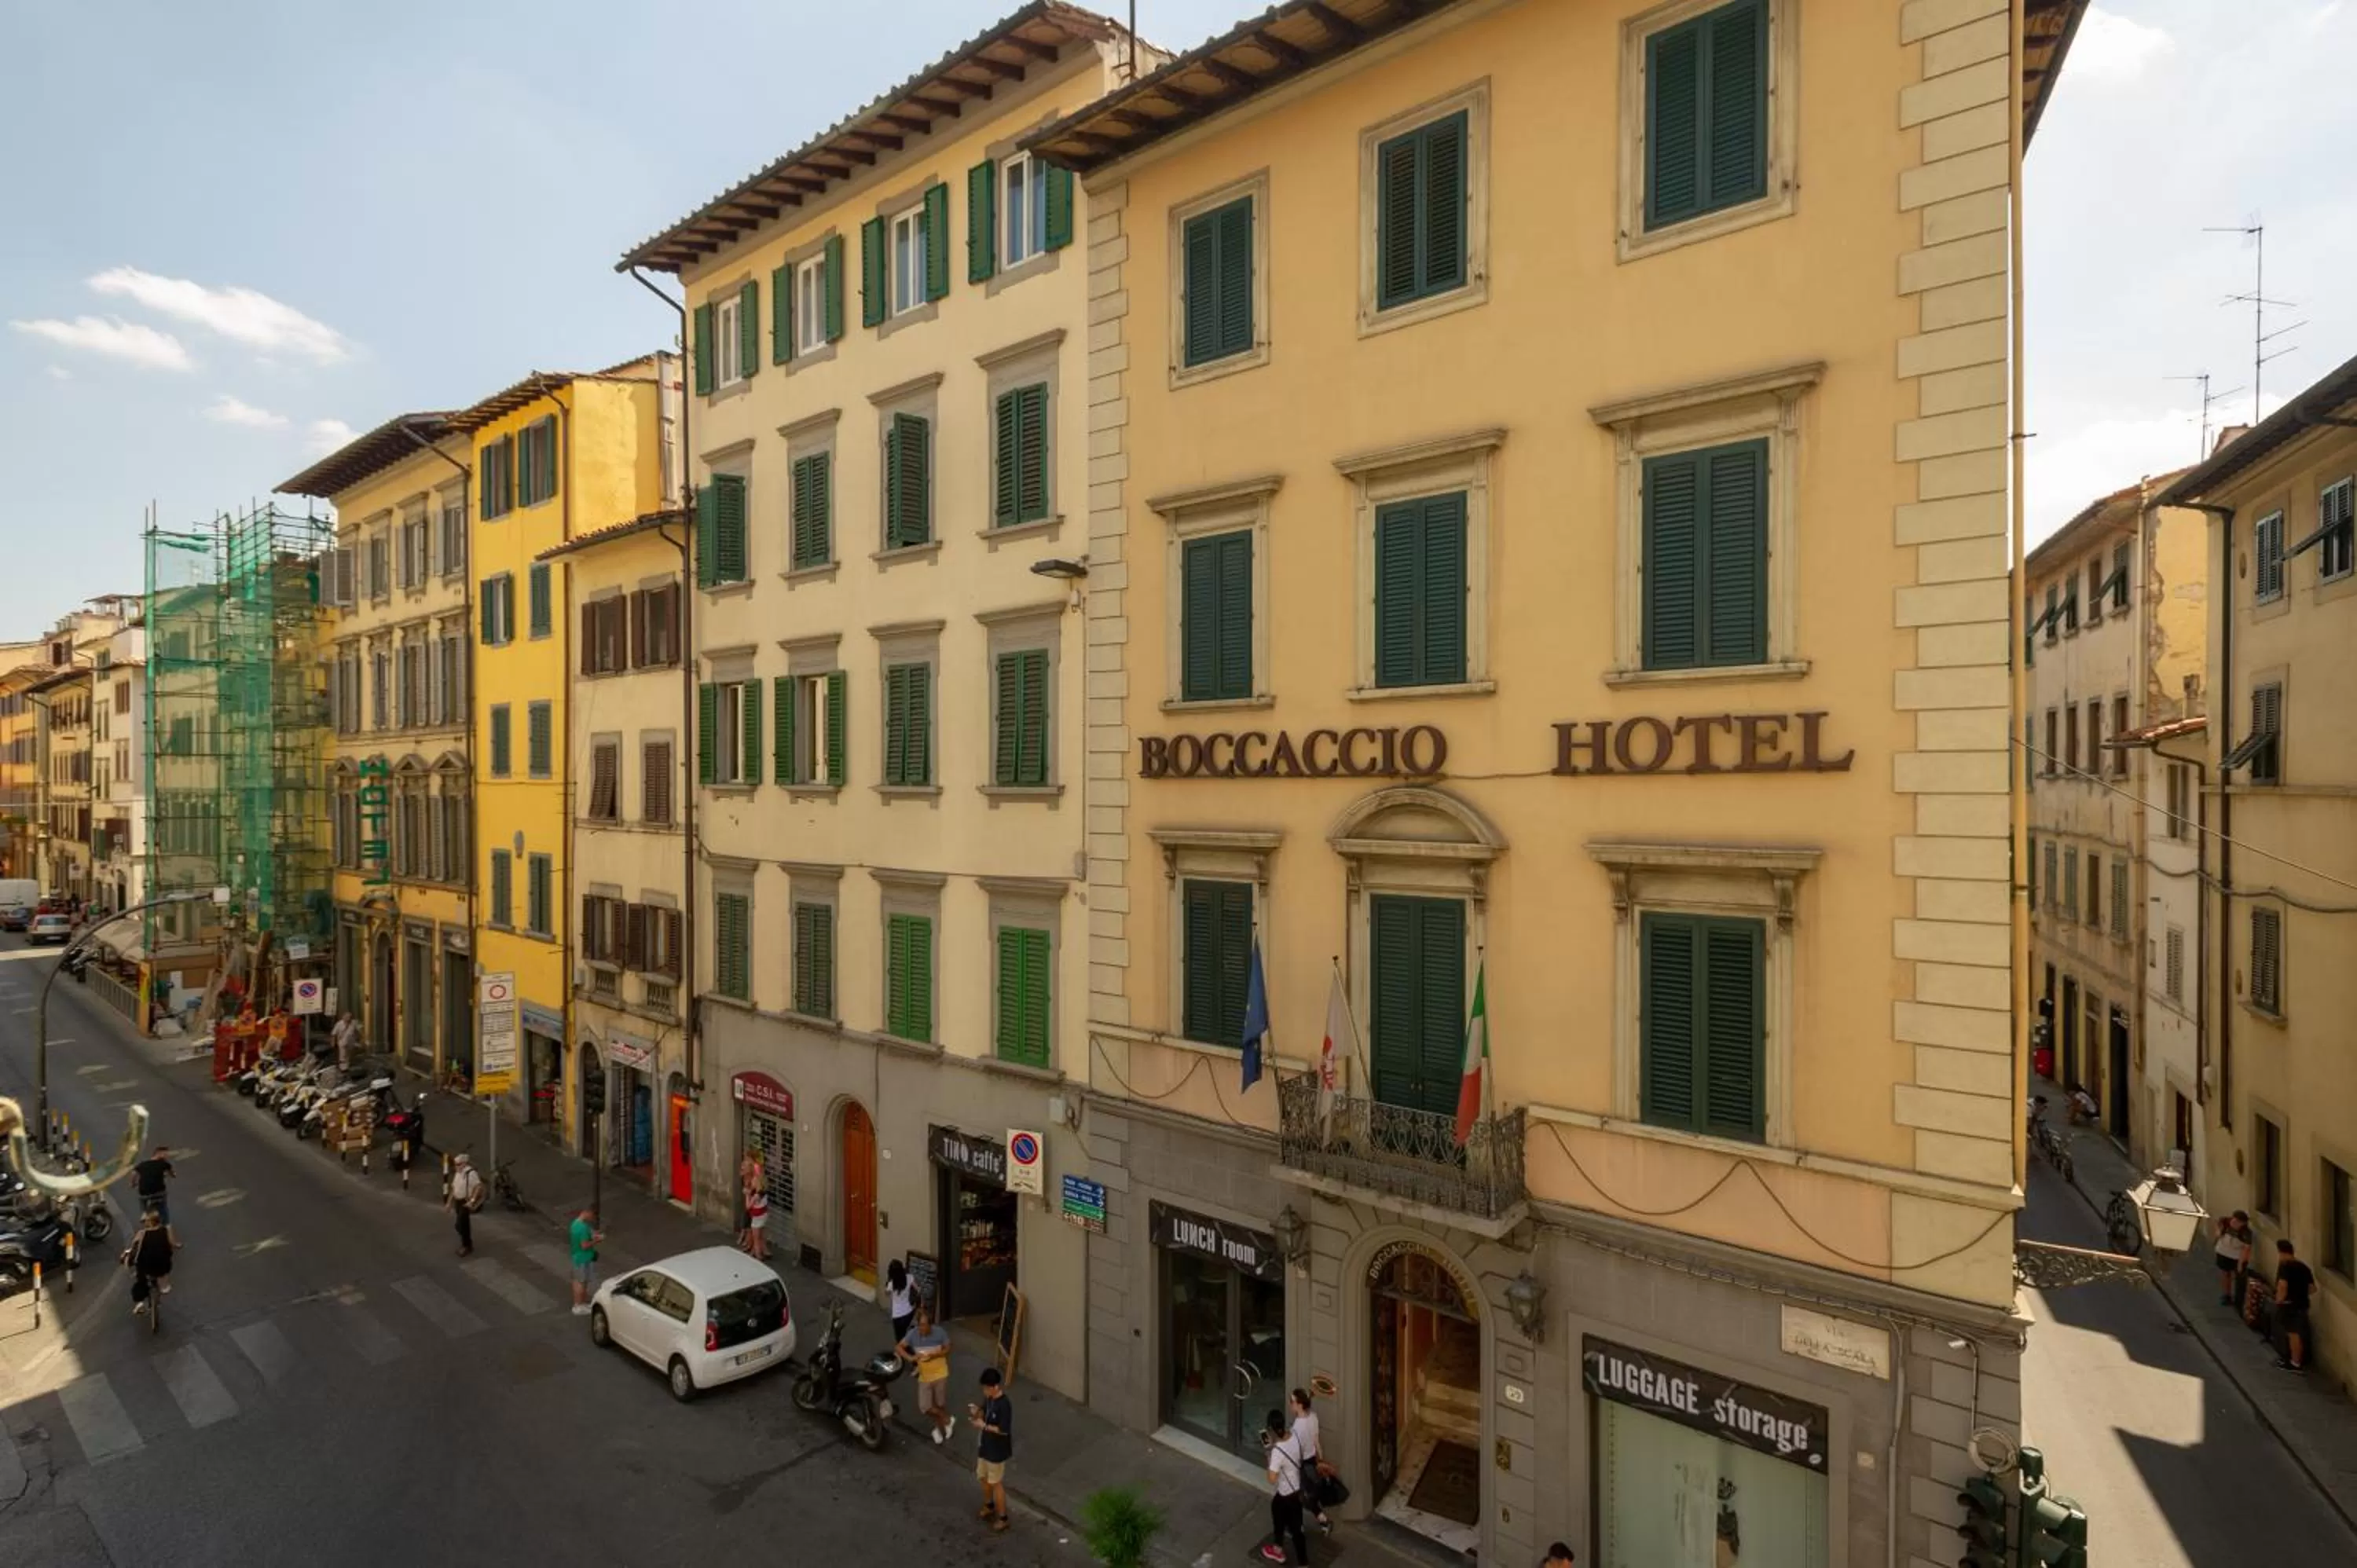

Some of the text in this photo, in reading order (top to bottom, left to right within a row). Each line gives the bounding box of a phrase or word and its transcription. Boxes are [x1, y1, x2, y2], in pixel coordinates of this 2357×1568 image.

[1138, 712, 1855, 778] BOCCACCIO HOTEL
[1173, 1218, 1255, 1266] LUNCH room
[1598, 1354, 1808, 1453] LUGGAGE storage
